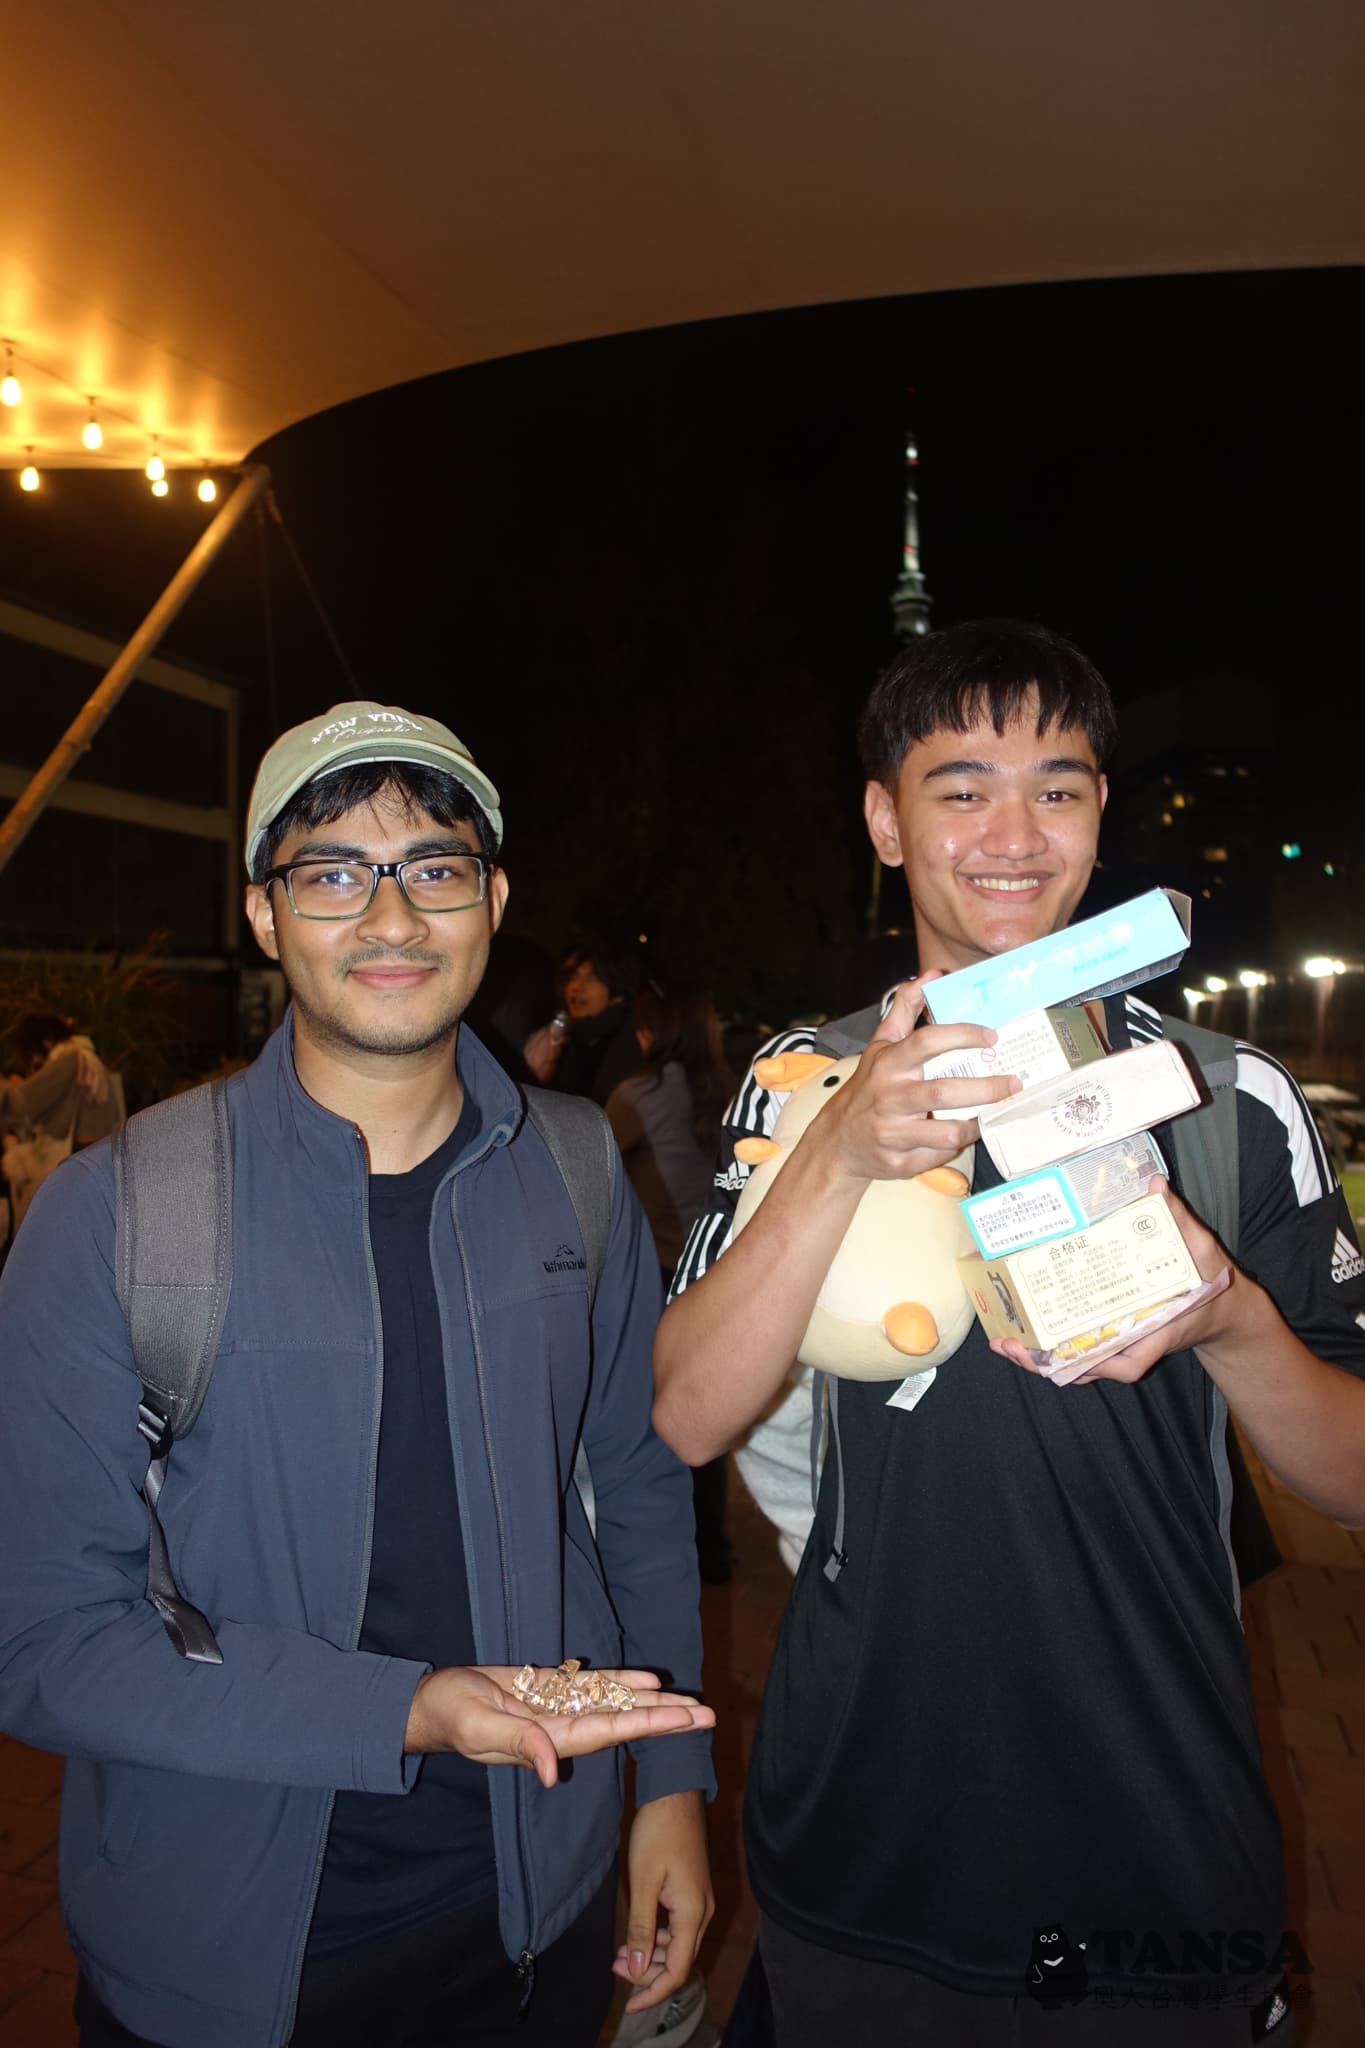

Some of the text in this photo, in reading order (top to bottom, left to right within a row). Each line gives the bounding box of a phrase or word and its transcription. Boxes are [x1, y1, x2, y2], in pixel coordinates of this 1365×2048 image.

[311, 717, 358, 745] NEW
[1049, 1235, 1088, 1261] 合格证
